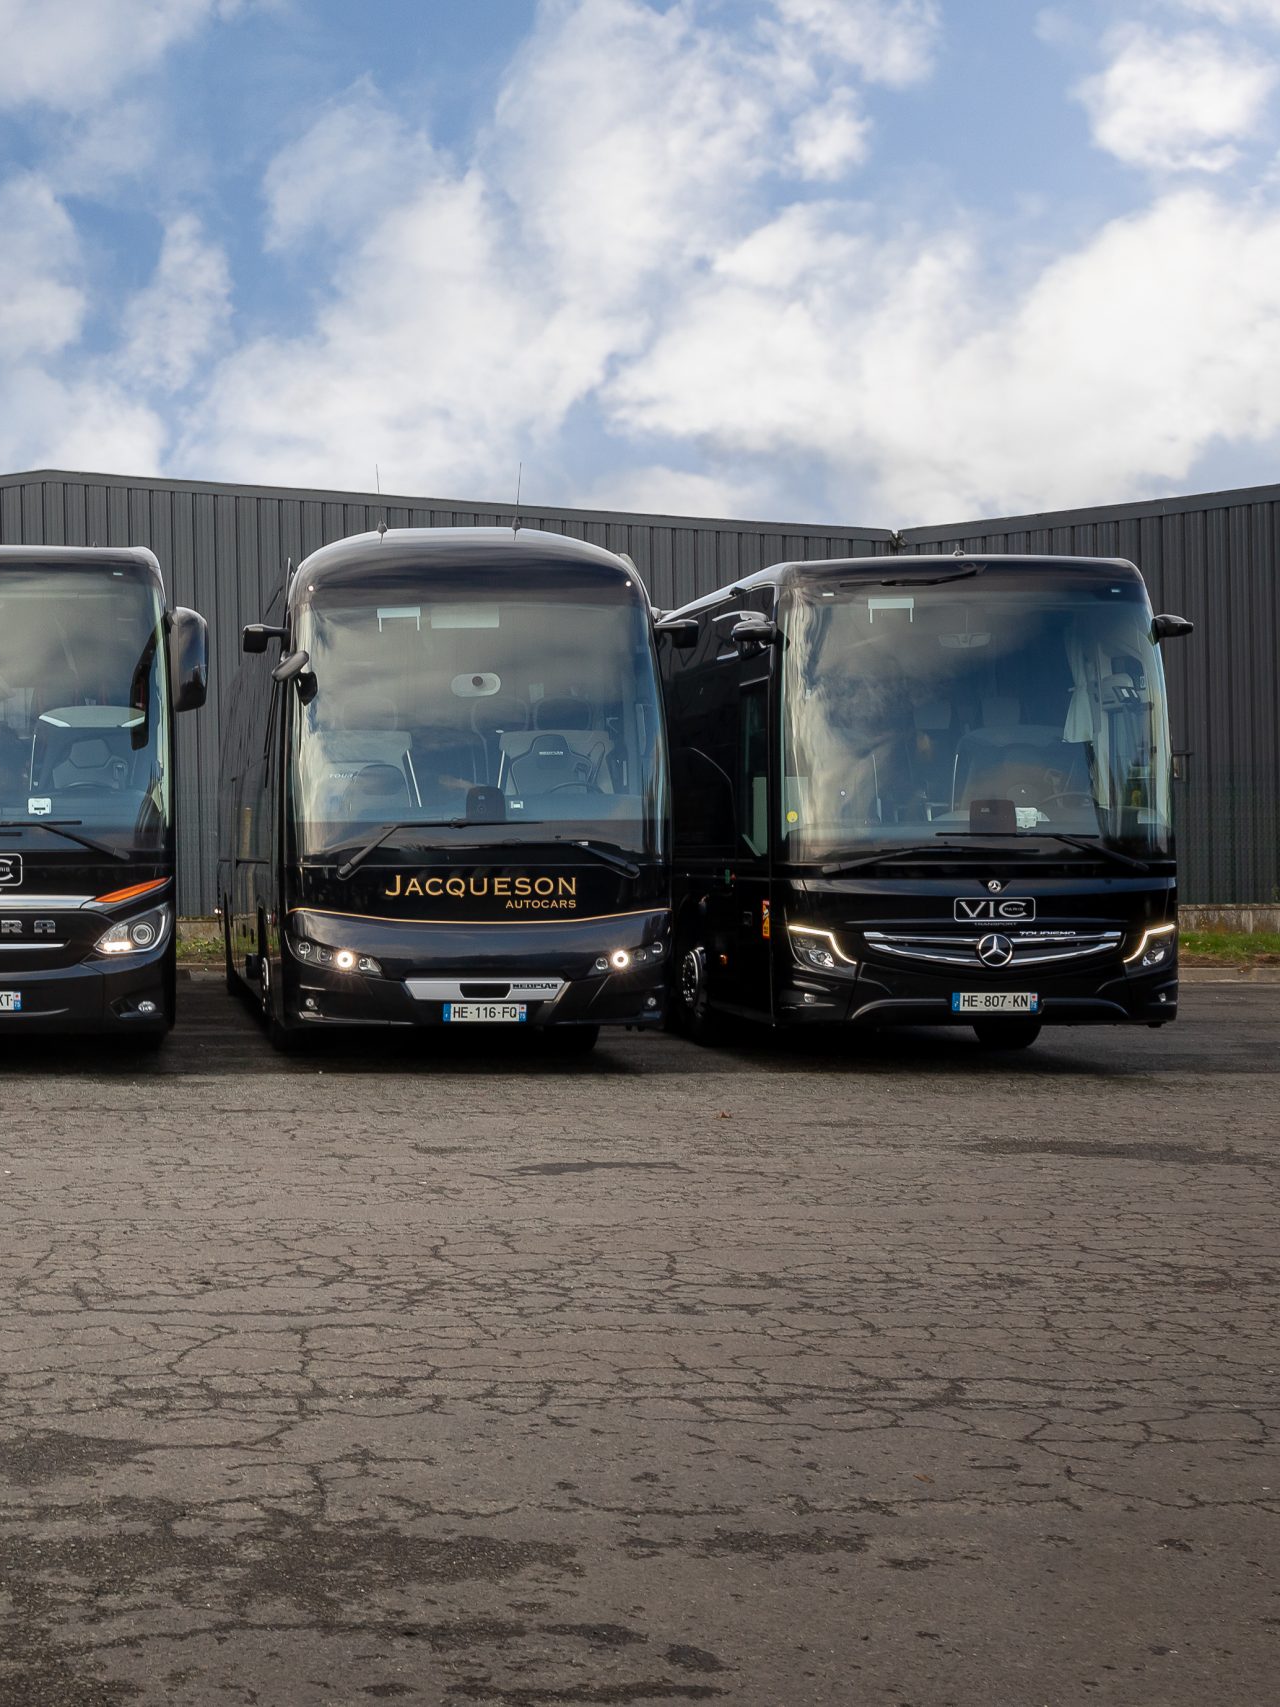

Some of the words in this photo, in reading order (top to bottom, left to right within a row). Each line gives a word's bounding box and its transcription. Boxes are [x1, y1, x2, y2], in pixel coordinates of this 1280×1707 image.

[385, 874, 577, 898] JACQUESON
[505, 899, 577, 909] AUTOCARS
[959, 901, 1028, 918] VIC
[962, 995, 1029, 1008] HE-807-KN
[453, 1006, 517, 1019] HE-116-FQ
